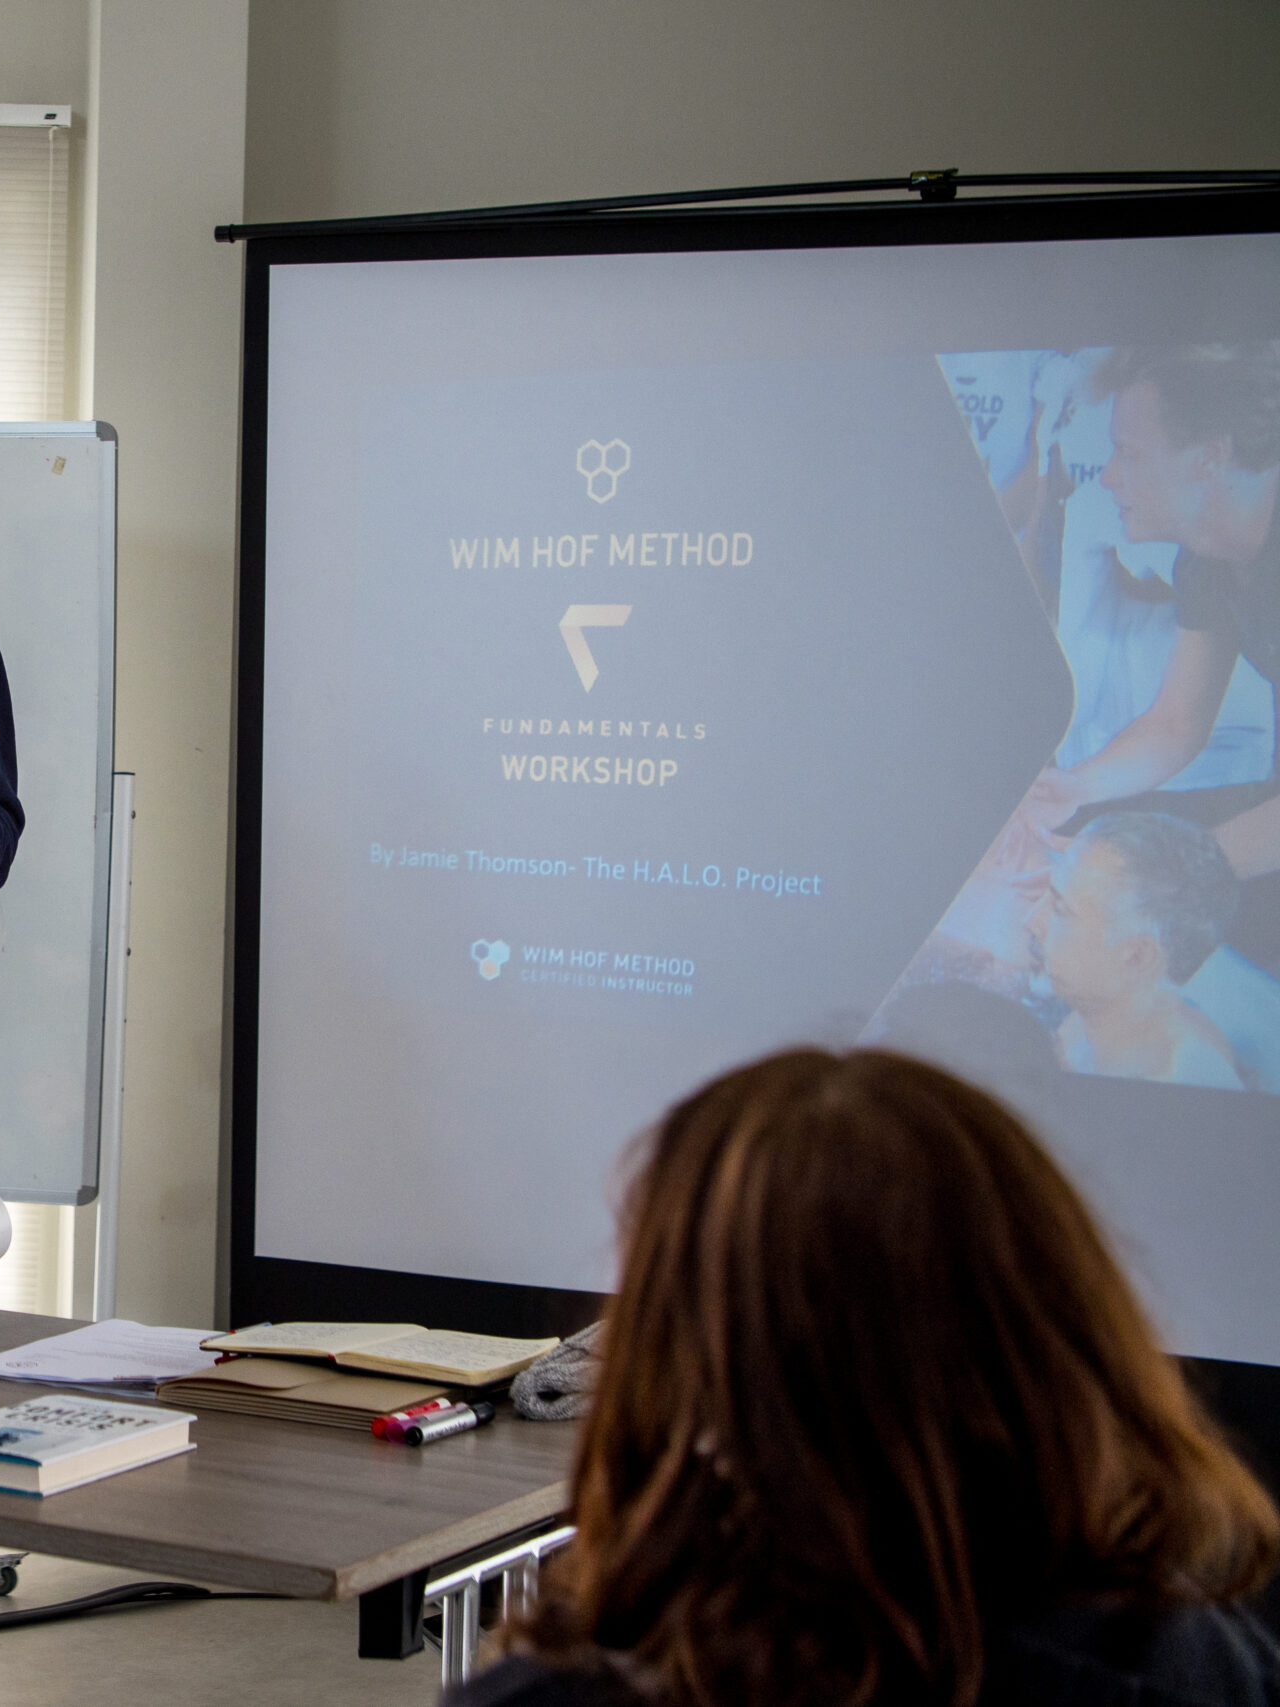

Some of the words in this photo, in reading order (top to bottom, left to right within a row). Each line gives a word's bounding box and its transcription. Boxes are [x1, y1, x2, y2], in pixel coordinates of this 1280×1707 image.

[449, 536, 520, 569] WIM
[532, 534, 599, 568] HOF
[608, 532, 754, 567] METHOD
[482, 717, 707, 740] FUNDAMENTALS
[500, 754, 679, 787] WORKSHOP
[369, 842, 395, 869] By
[398, 845, 459, 871] Jamie
[583, 857, 626, 881] The
[632, 860, 727, 889] H.A.L.O.
[736, 867, 822, 898] Project
[522, 946, 565, 965] WIM
[570, 950, 608, 968] HOF
[613, 953, 696, 977] METHOD
[601, 976, 693, 996] INSTRUCTOR
